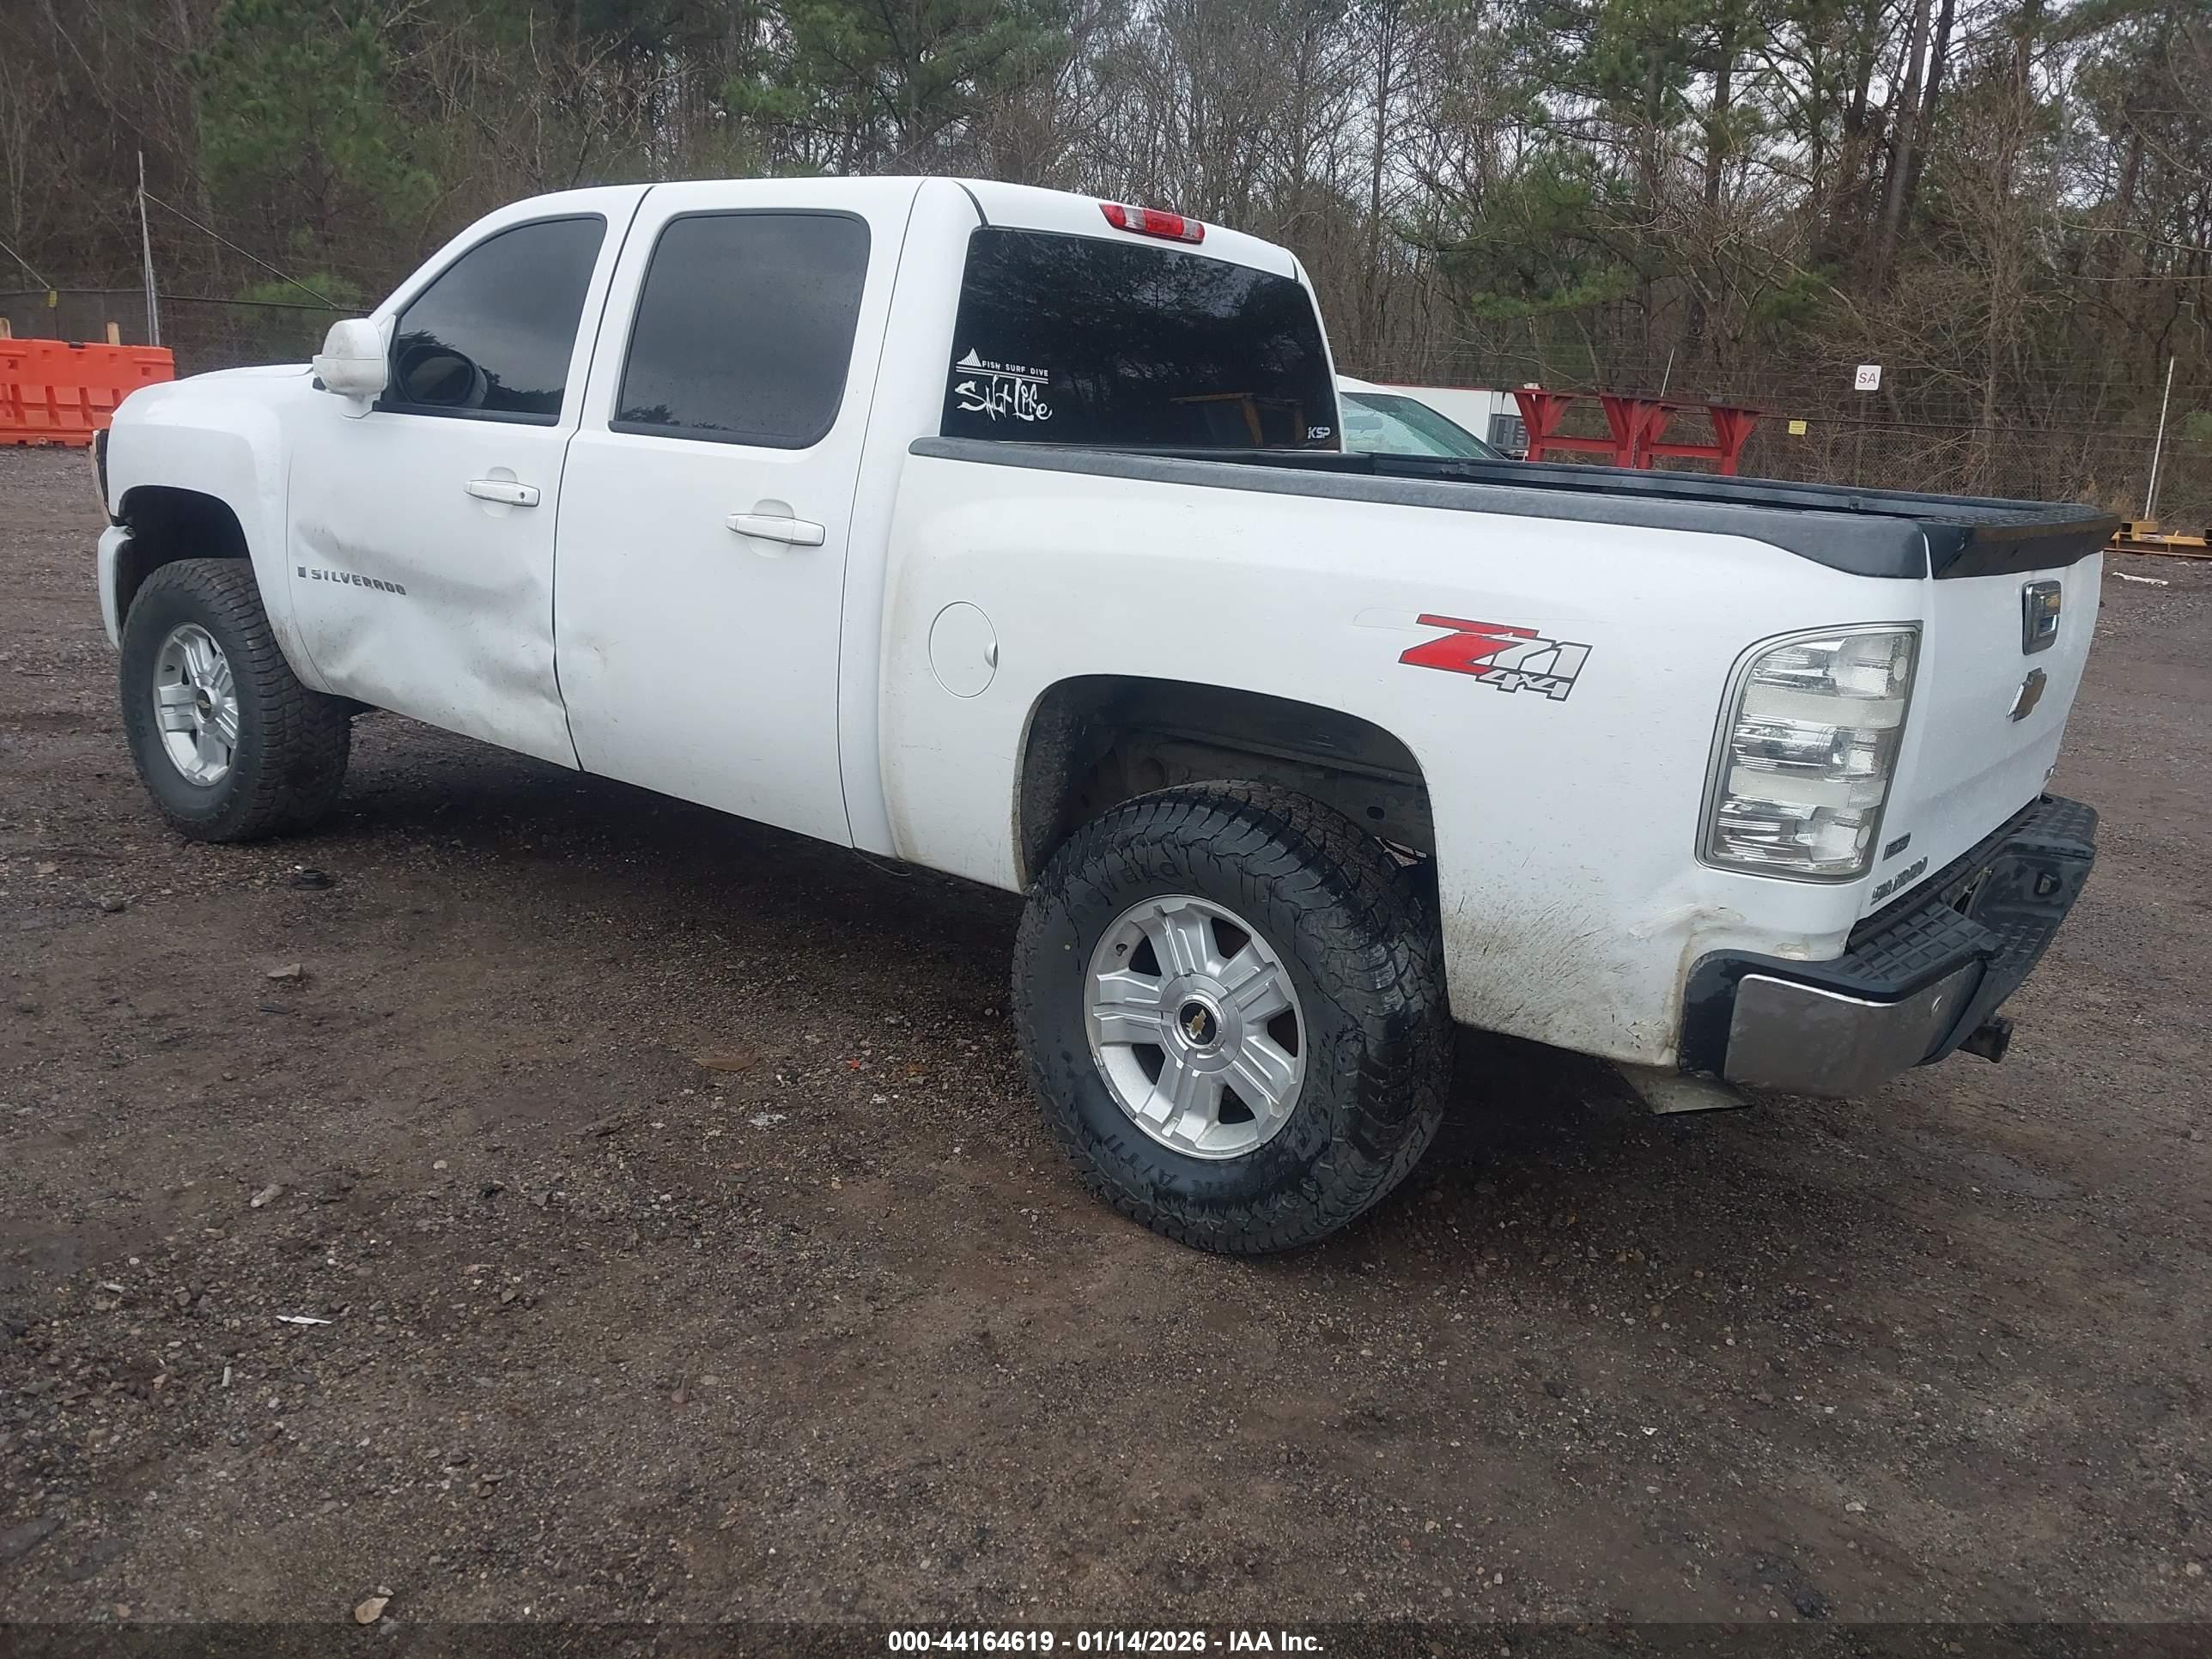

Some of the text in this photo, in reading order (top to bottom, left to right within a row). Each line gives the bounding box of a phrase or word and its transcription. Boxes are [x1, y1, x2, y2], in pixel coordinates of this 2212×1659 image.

[982, 361, 1048, 376] FISH SURF DIVE
[1858, 373, 1876, 384] SA
[1308, 427, 1330, 439] KSP
[311, 569, 406, 596] SILVERADO
[1398, 613, 1593, 684] Z71
